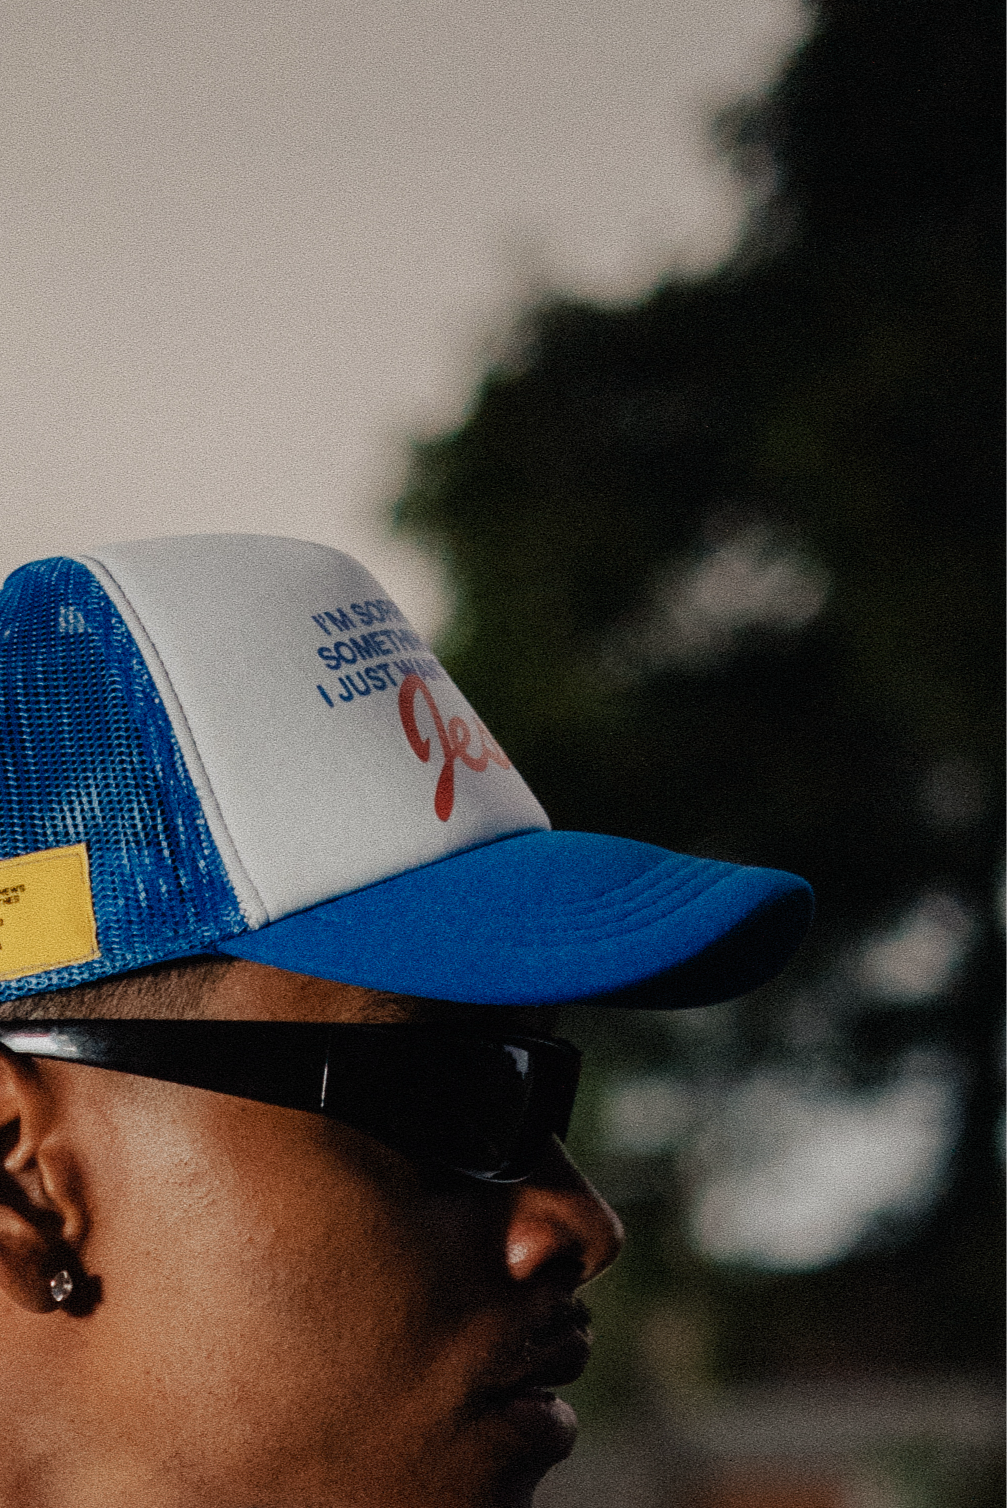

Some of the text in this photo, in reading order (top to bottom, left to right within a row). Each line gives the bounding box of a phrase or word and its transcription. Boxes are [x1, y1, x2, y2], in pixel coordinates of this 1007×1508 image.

[311, 607, 357, 635] I'M
[317, 684, 334, 708] I
[338, 662, 398, 702] JUST
